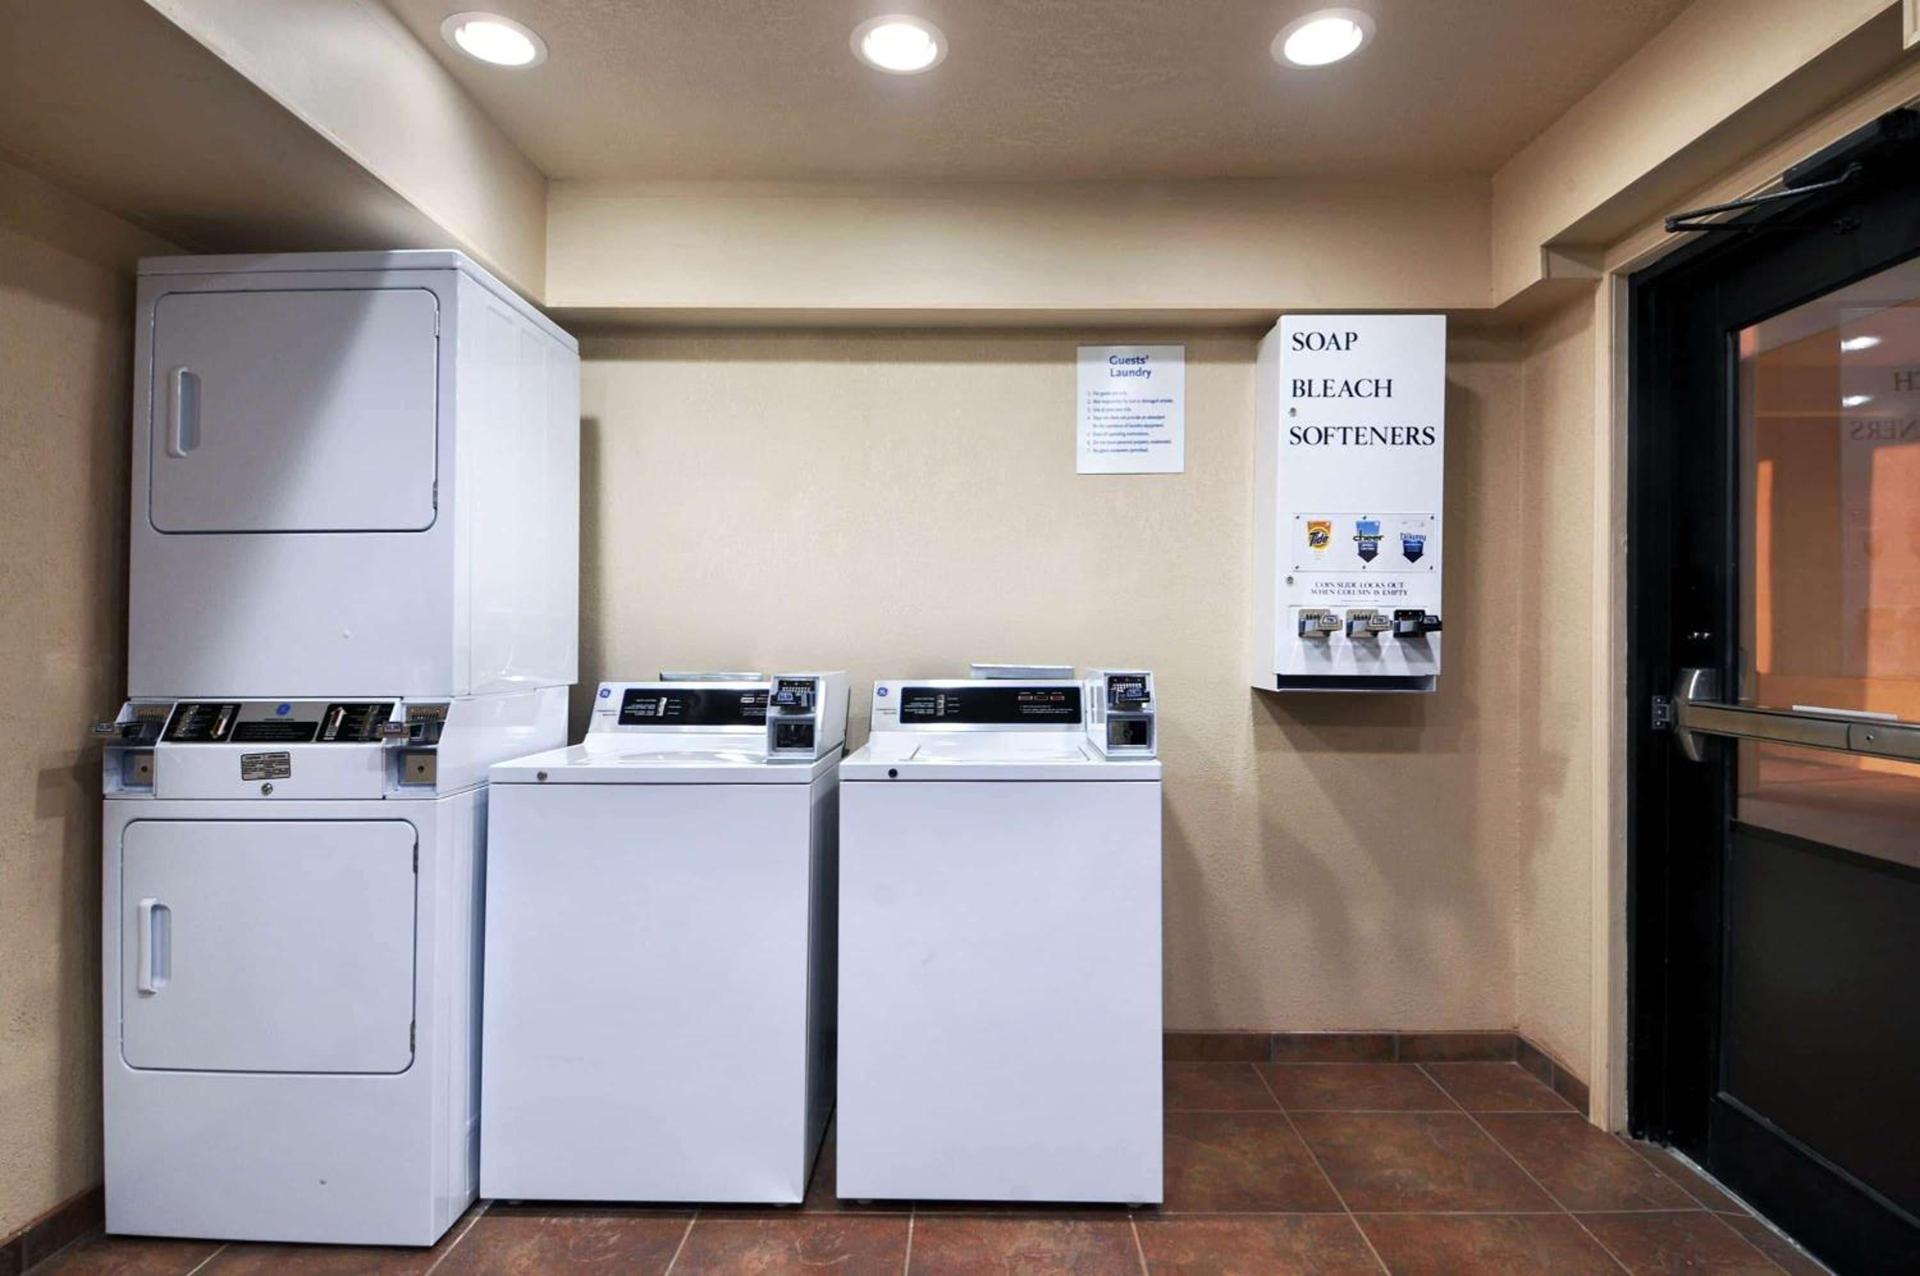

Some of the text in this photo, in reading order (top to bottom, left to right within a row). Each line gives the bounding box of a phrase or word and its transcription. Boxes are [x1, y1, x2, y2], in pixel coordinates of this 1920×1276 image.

[1292, 331, 1358, 351] SOAP
[1110, 367, 1151, 379] Laundry
[1292, 378, 1392, 398] BLEACH
[1289, 426, 1435, 446] SOFTENERS
[1309, 531, 1329, 547] Tide
